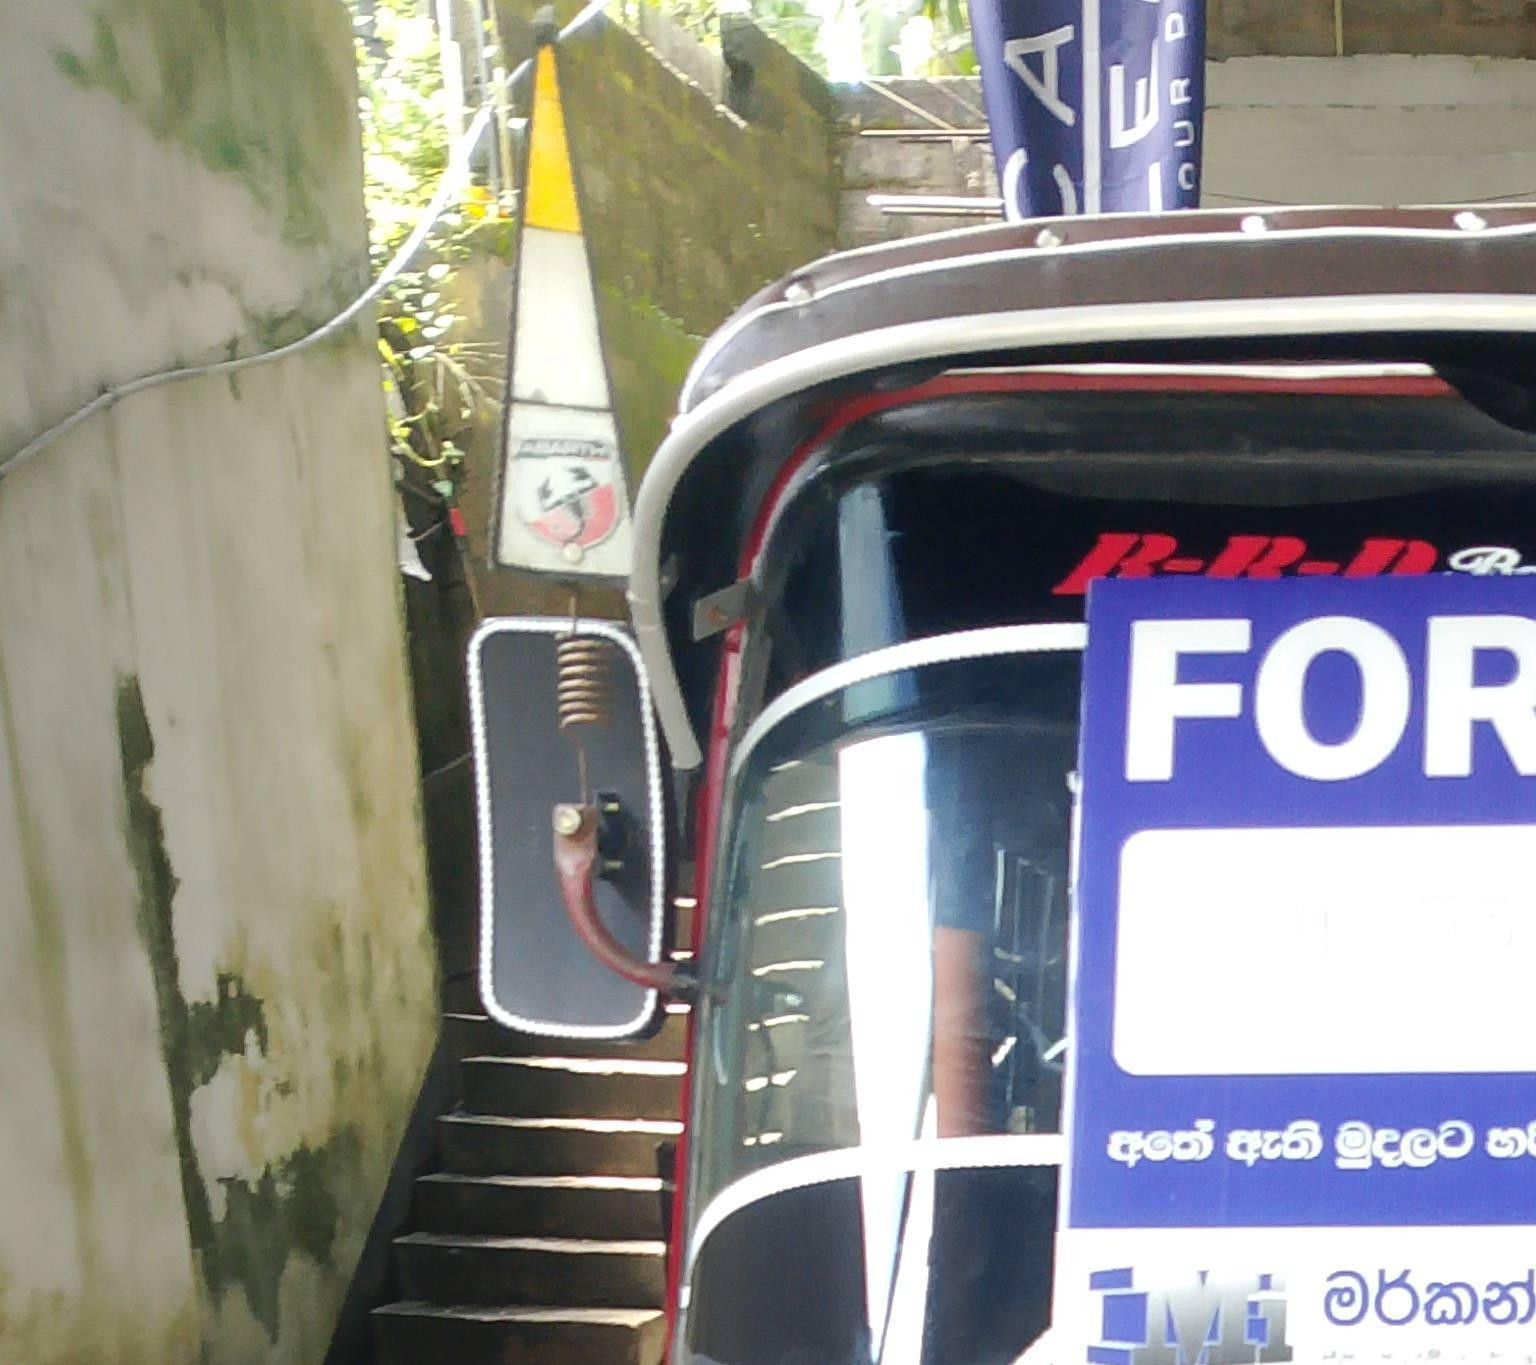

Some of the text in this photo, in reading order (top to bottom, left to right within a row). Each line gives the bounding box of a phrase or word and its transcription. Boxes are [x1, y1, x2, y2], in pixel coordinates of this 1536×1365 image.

[1106, 1118, 1216, 1167] අතේ
[1225, 1119, 1323, 1167] ඇති
[1334, 1120, 1474, 1170] මුදලට
